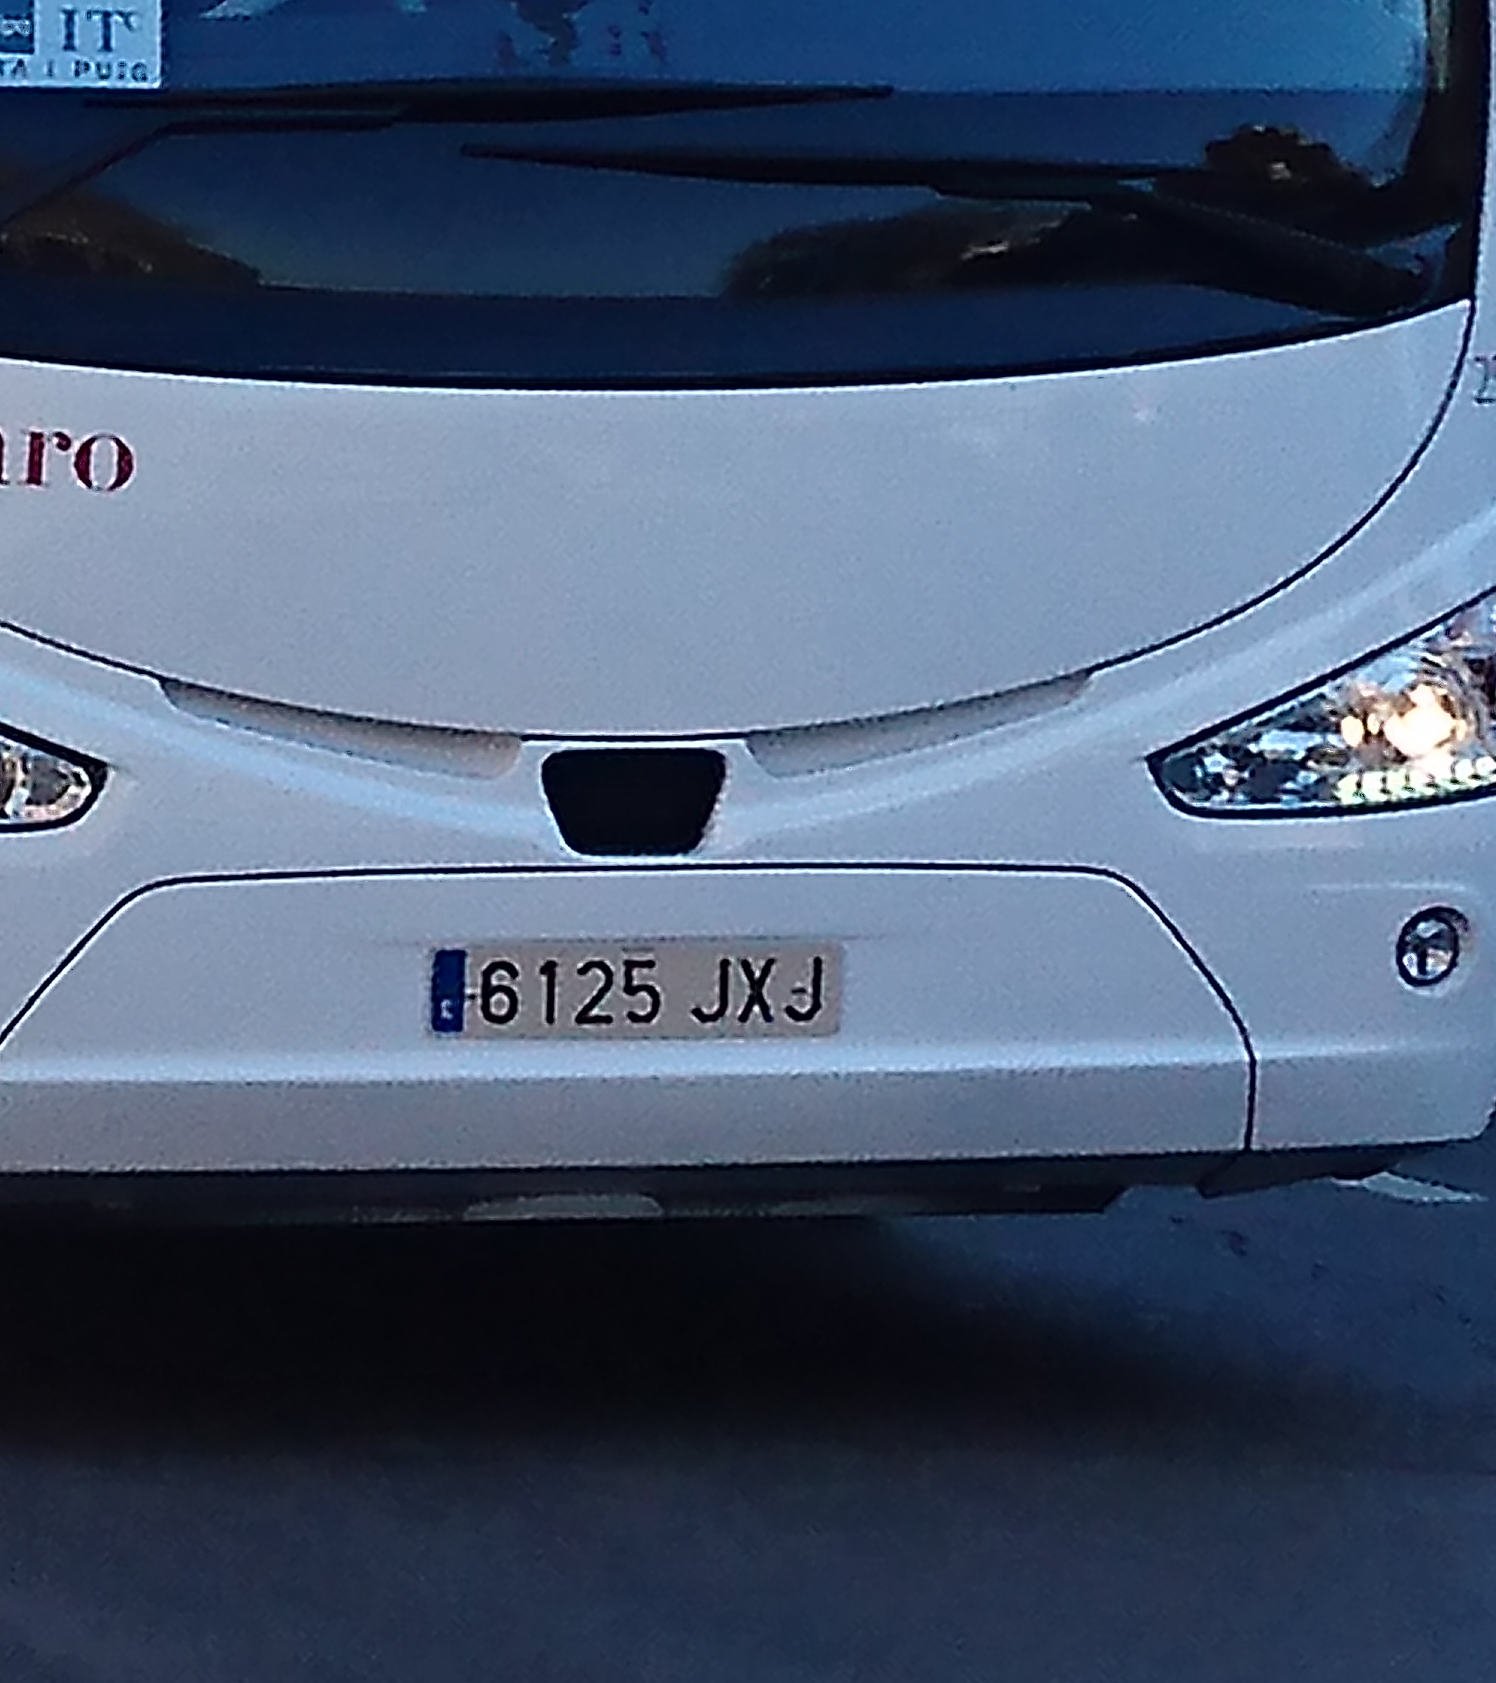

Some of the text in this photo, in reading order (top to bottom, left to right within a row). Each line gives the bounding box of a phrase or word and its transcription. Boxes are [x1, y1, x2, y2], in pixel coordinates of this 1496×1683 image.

[73, 59, 150, 83] PUIG
[479, 959, 663, 1026] 6125
[690, 957, 823, 1024] JXJ
